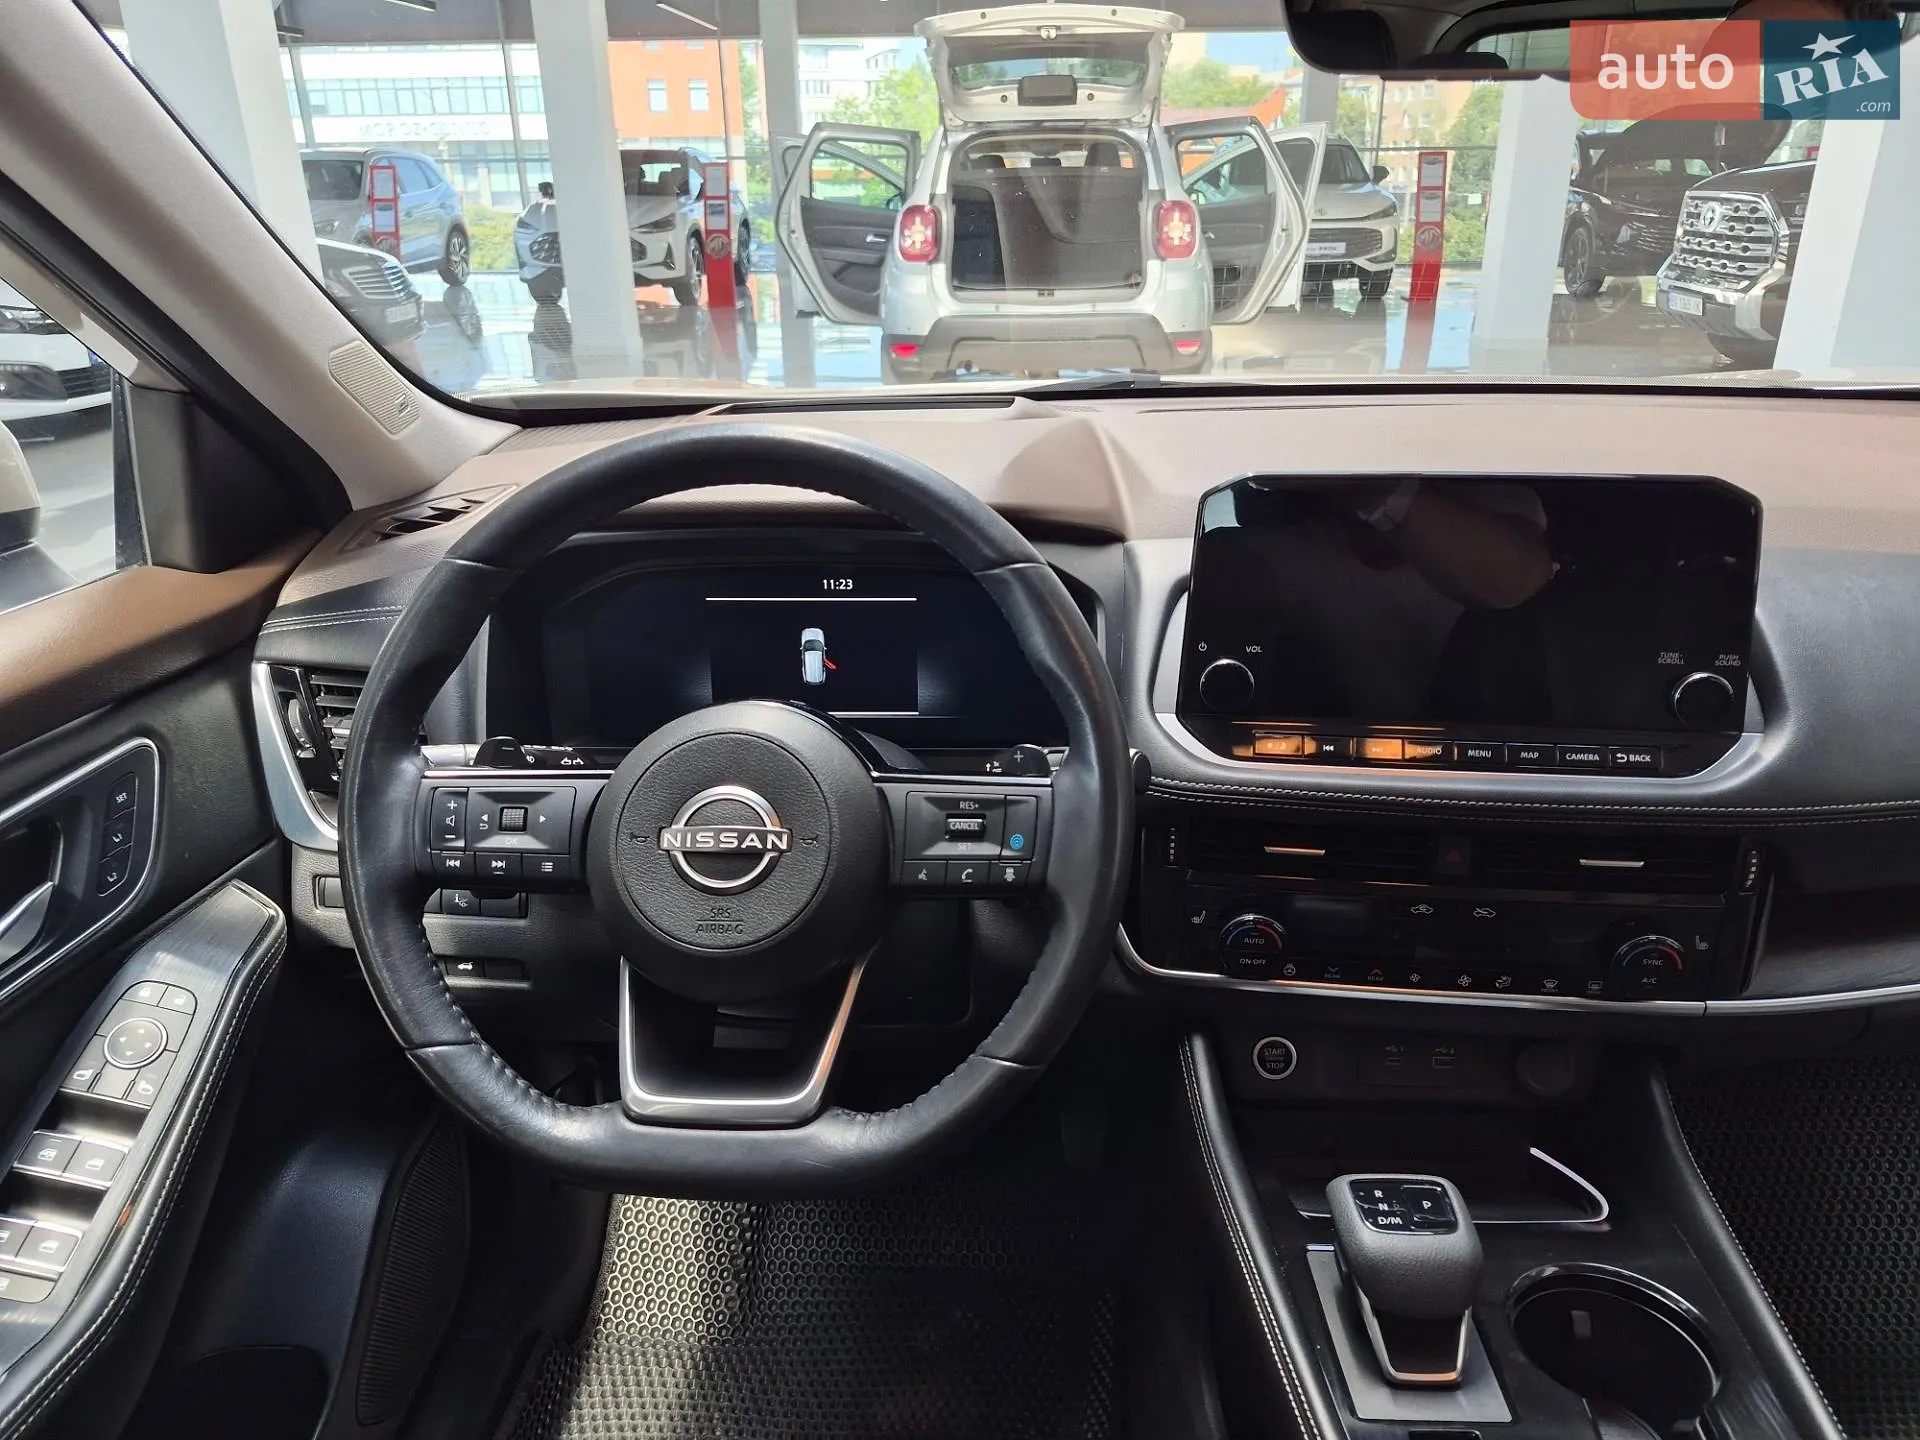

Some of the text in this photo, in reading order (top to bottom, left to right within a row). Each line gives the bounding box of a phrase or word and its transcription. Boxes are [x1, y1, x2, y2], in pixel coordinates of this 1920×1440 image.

[822, 579, 854, 590] 11:23
[1245, 645, 1263, 653] VOL
[1415, 746, 1442, 755] AUDIO
[1467, 749, 1492, 758] MENU
[1520, 751, 1539, 760] MAP
[1565, 752, 1600, 761] CAMERA
[1629, 753, 1651, 762] BACK
[115, 792, 128, 804] SET
[950, 821, 980, 831] CANCEL
[505, 837, 519, 845] OK
[662, 831, 789, 850] NISSAN
[709, 907, 732, 919] SRS
[695, 923, 744, 935] AIRBAG
[1243, 937, 1265, 946] AUTO
[1642, 958, 1664, 967] SYNC
[1263, 1047, 1286, 1056] START
[1265, 1061, 1285, 1070] STOP
[1373, 1189, 1384, 1198] R
[1377, 1202, 1389, 1211] N
[1422, 1200, 1432, 1210] P
[1377, 1216, 1403, 1225] D/M
